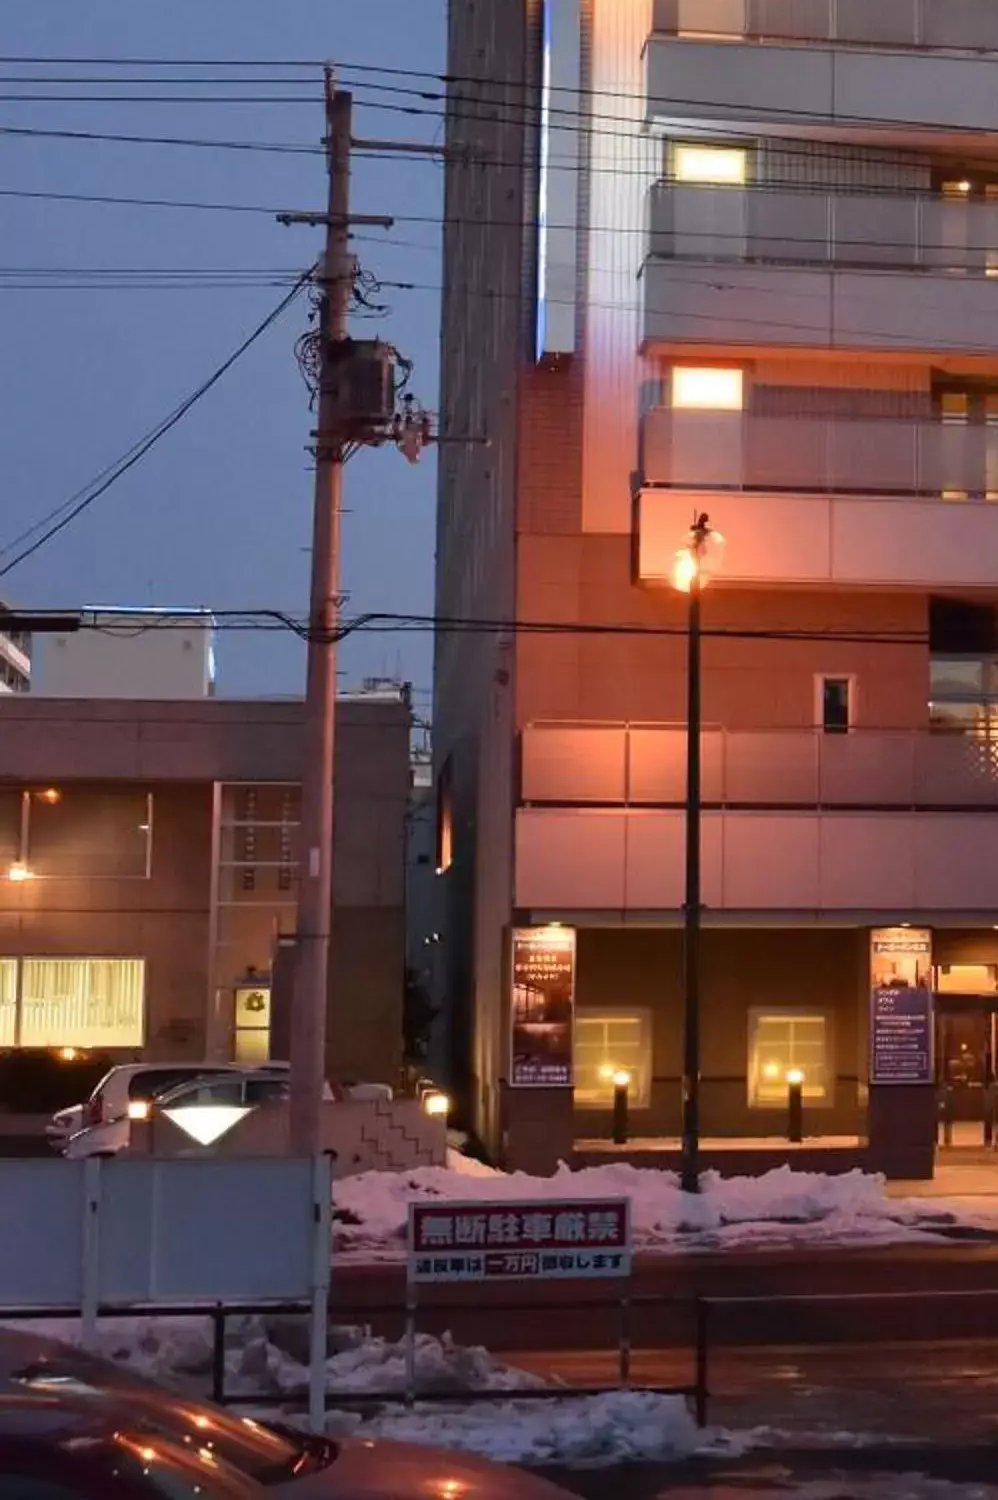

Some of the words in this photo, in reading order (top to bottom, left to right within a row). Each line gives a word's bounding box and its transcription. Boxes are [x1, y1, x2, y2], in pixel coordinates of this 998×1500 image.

[420, 1211, 619, 1245] 無断駐車厳禁
